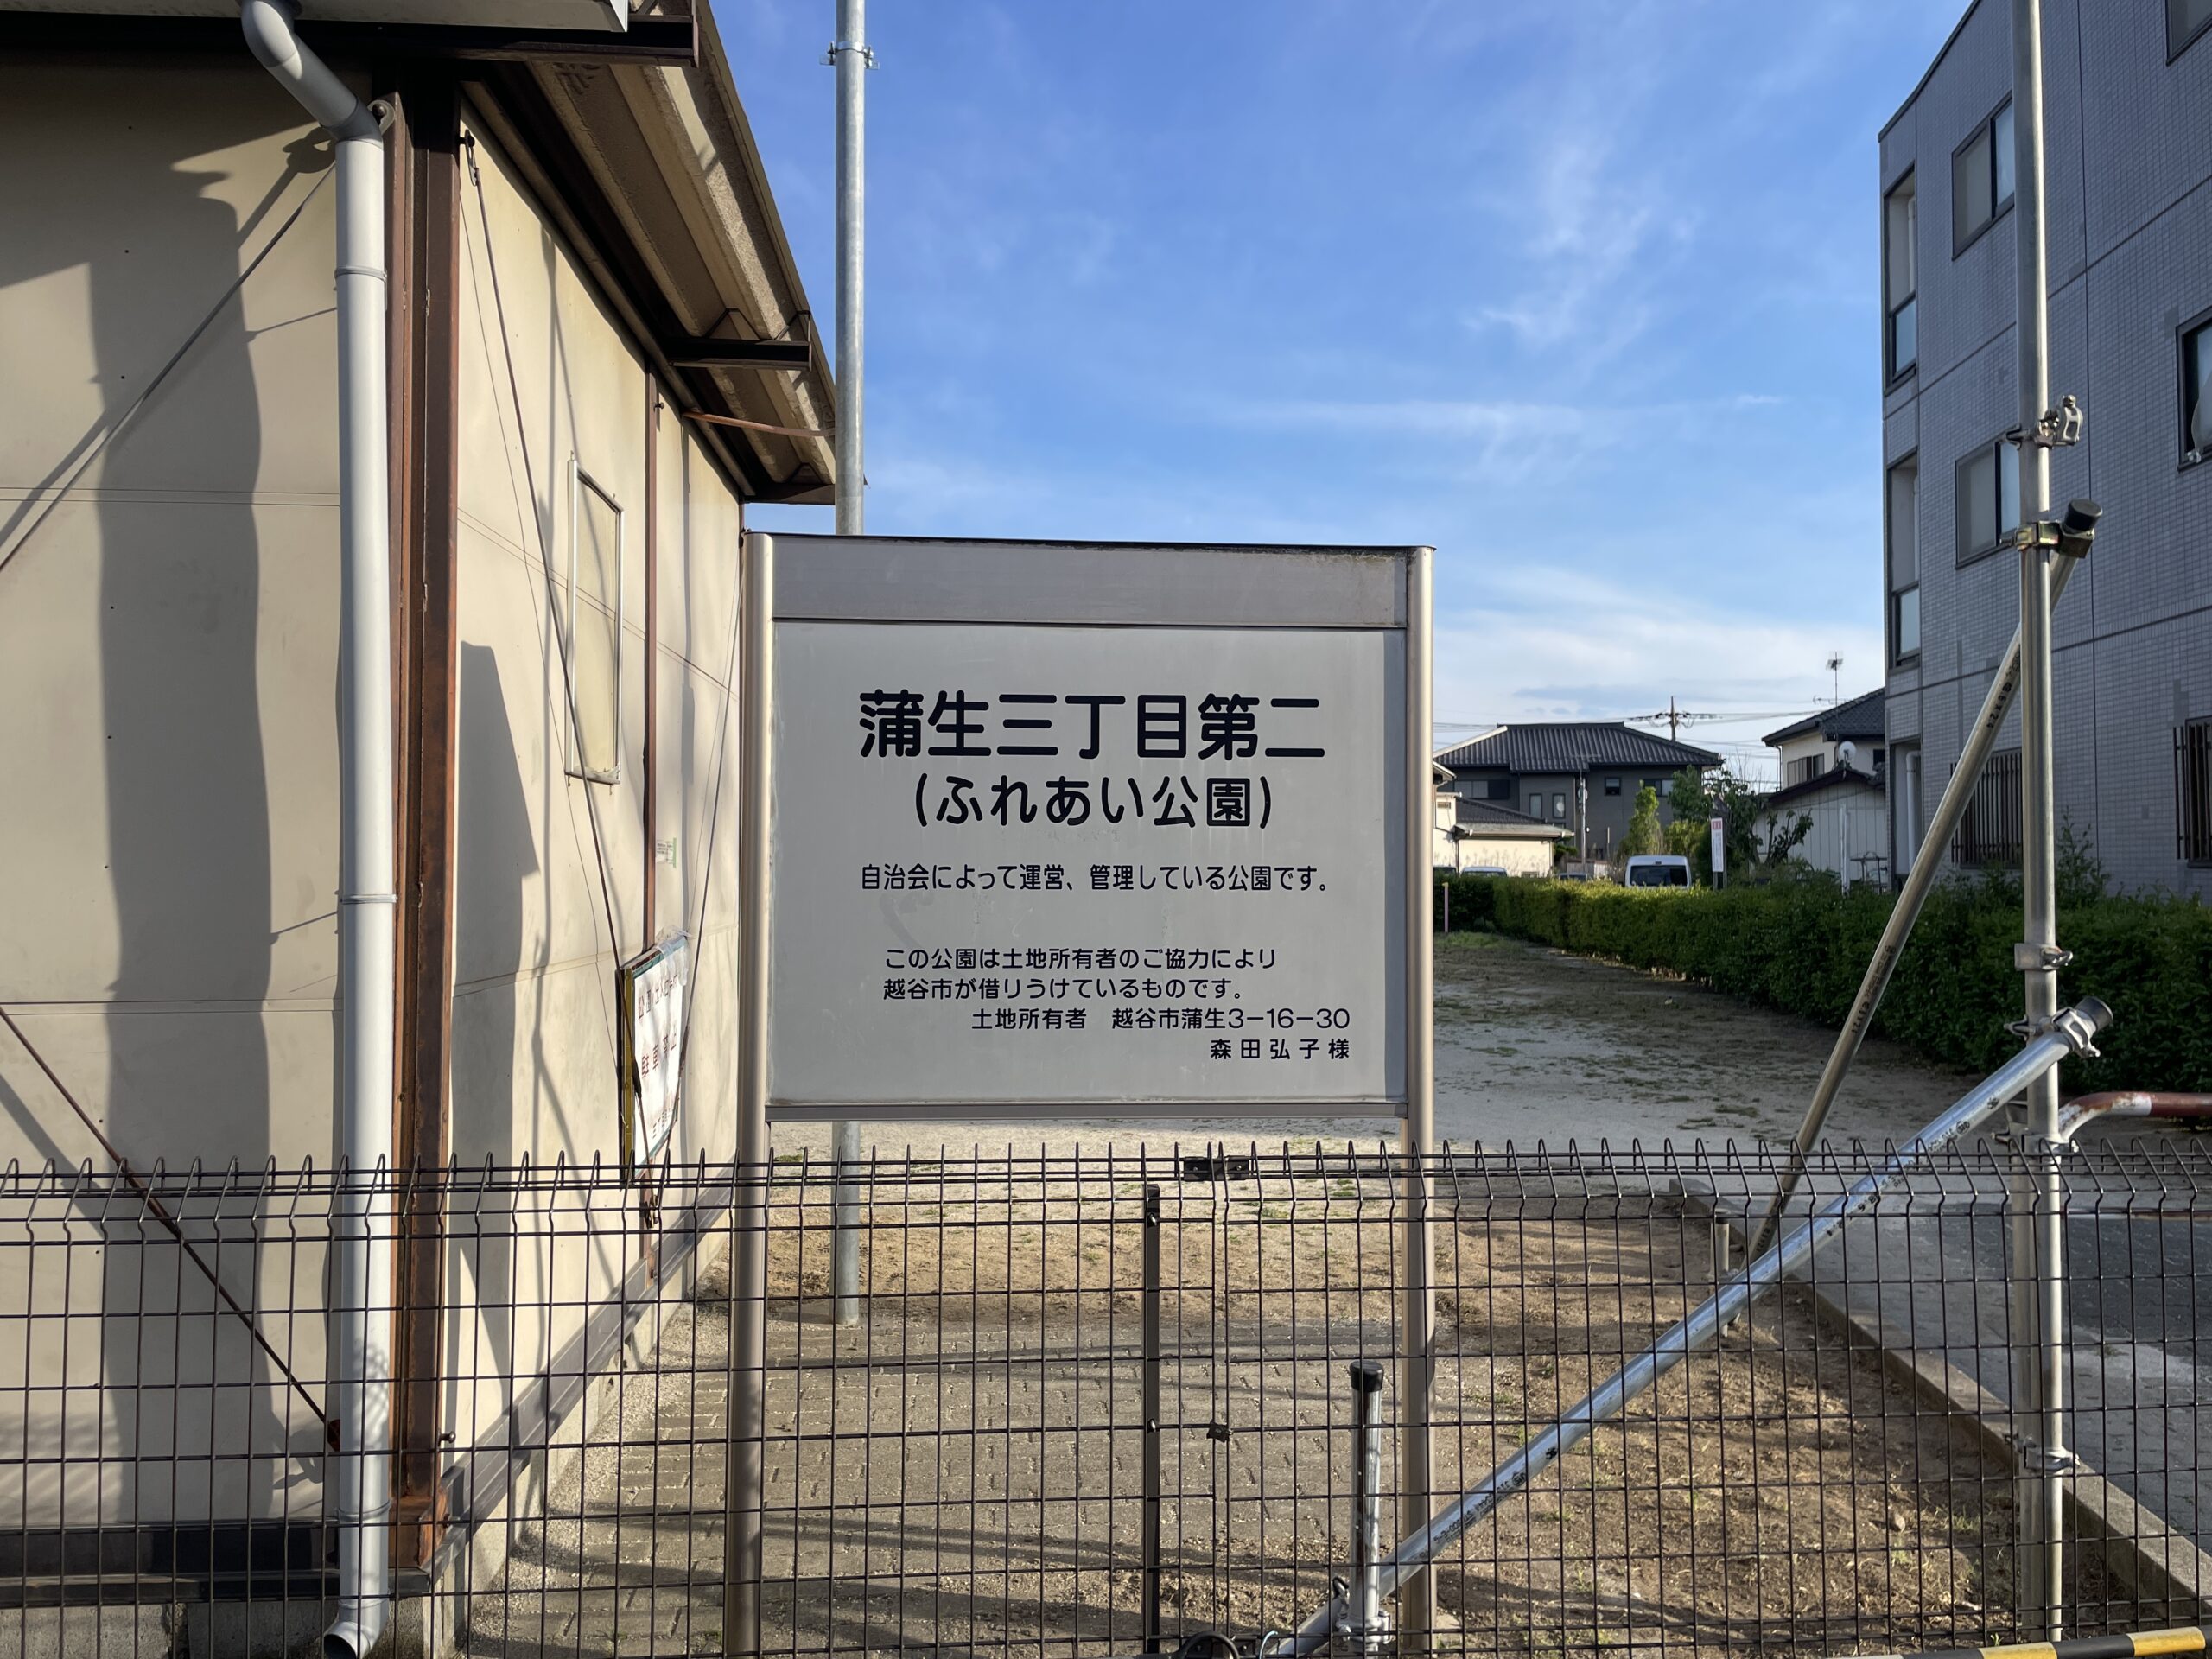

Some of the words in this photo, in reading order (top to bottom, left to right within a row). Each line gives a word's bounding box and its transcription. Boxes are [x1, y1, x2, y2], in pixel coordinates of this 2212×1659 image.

[860, 689, 1325, 760] 蒲生三丁目第二
[916, 773, 1272, 829] (ふれあい公園)
[861, 863, 1326, 892] 自治会によって運営、管理している公園です。
[886, 947, 1275, 969] この公園は土地所有者のご協力により
[883, 977, 1241, 1001] 越谷市が借りうけているものです。
[972, 1007, 1087, 1030] 土地所有者
[1112, 1007, 1351, 1030] 越谷市蒲生3-16-30
[1210, 1038, 1350, 1060] 森田弘子様
